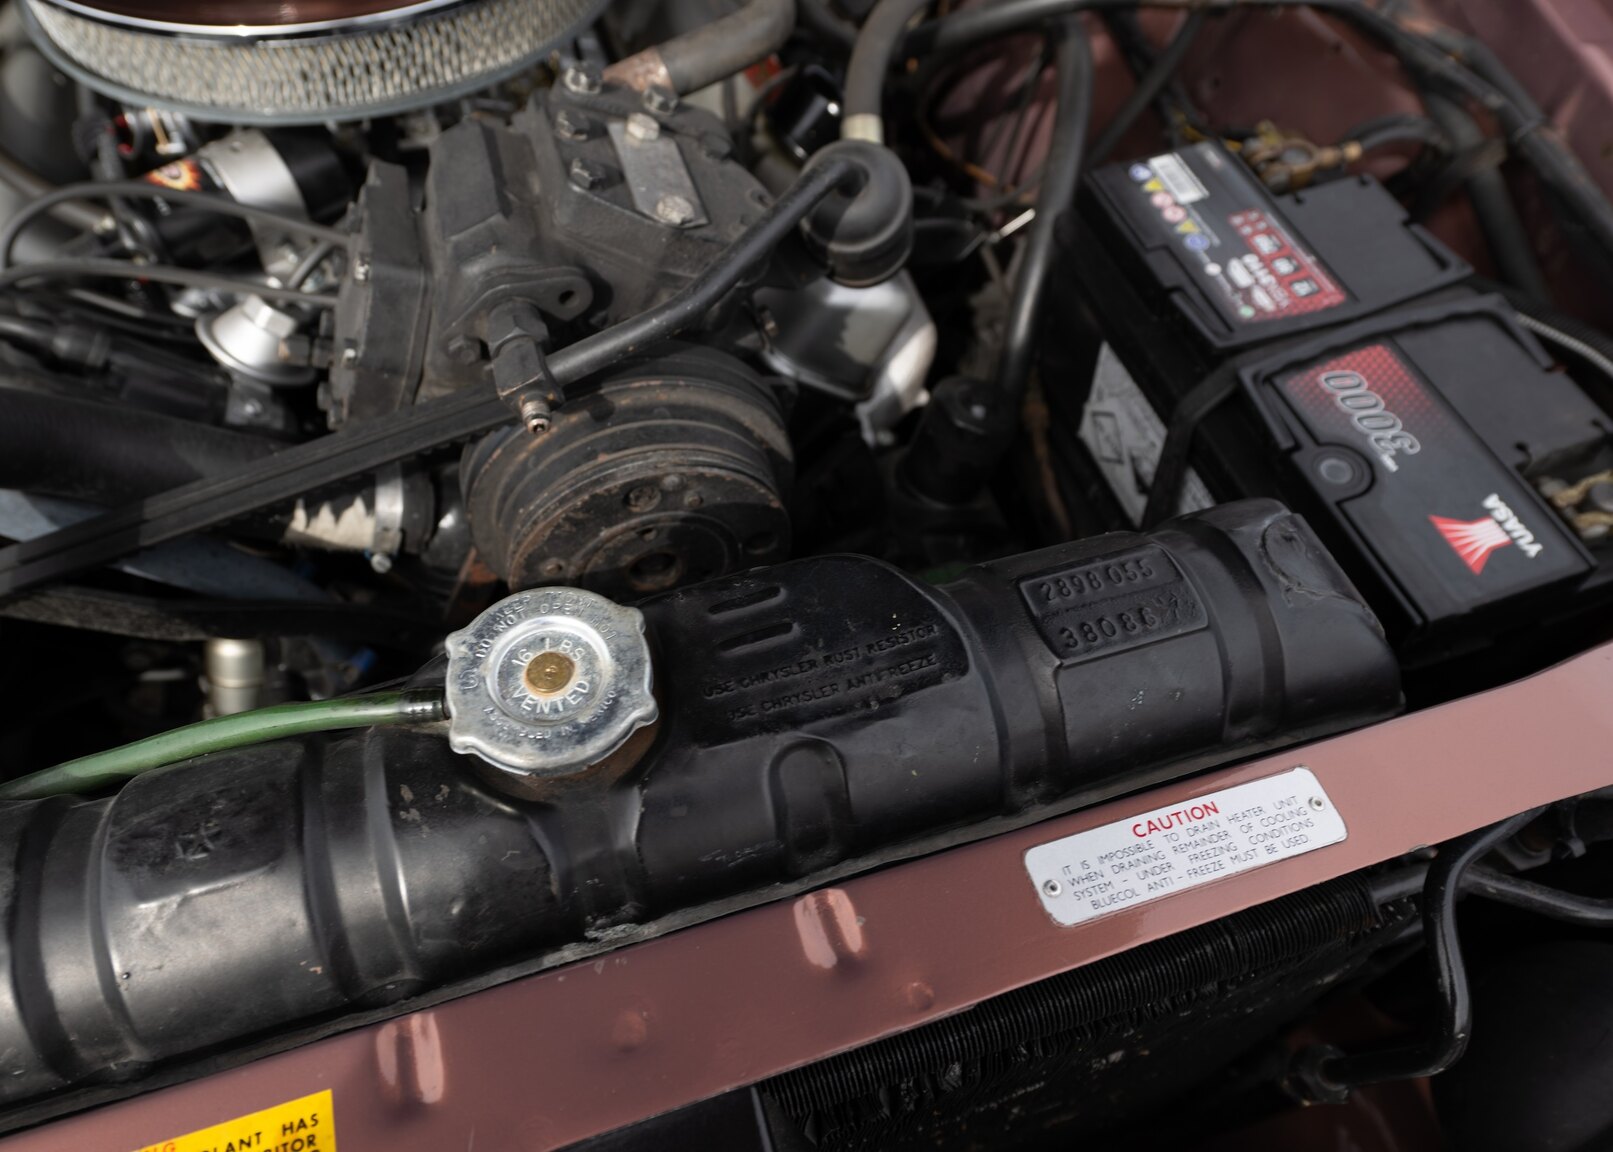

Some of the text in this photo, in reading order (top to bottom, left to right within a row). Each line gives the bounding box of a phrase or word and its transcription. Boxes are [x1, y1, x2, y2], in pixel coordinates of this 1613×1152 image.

[1319, 370, 1421, 456] 3000
[1481, 492, 1544, 559] YUASA
[511, 637, 586, 667] 16 LBS
[740, 659, 818, 688] CHRYSLER
[823, 647, 861, 665] RUST
[866, 625, 937, 655] RESISTOR
[511, 680, 591, 715] VENTED
[761, 684, 840, 711] CHRYSLER
[1062, 796, 1299, 876] IT IS IMPOSSIBLE TO DRAIN HEATER UNIT
[1067, 807, 1308, 887] WHEN DRAINING REMAINDER OF COOLING
[1132, 801, 1219, 838] CAUTION
[1073, 881, 1115, 901] SYSTEM
[1136, 861, 1176, 881] UNDER
[1187, 842, 1238, 865] FREEZING
[1248, 818, 1315, 845] CONDITIONS
[1090, 887, 1141, 910] BLUECOL
[1147, 876, 1175, 893] ANTI
[1186, 860, 1226, 879] FREEZE
[1229, 848, 1258, 865] MUST
[1264, 844, 1279, 855] BE
[281, 1113, 319, 1137] HAS
